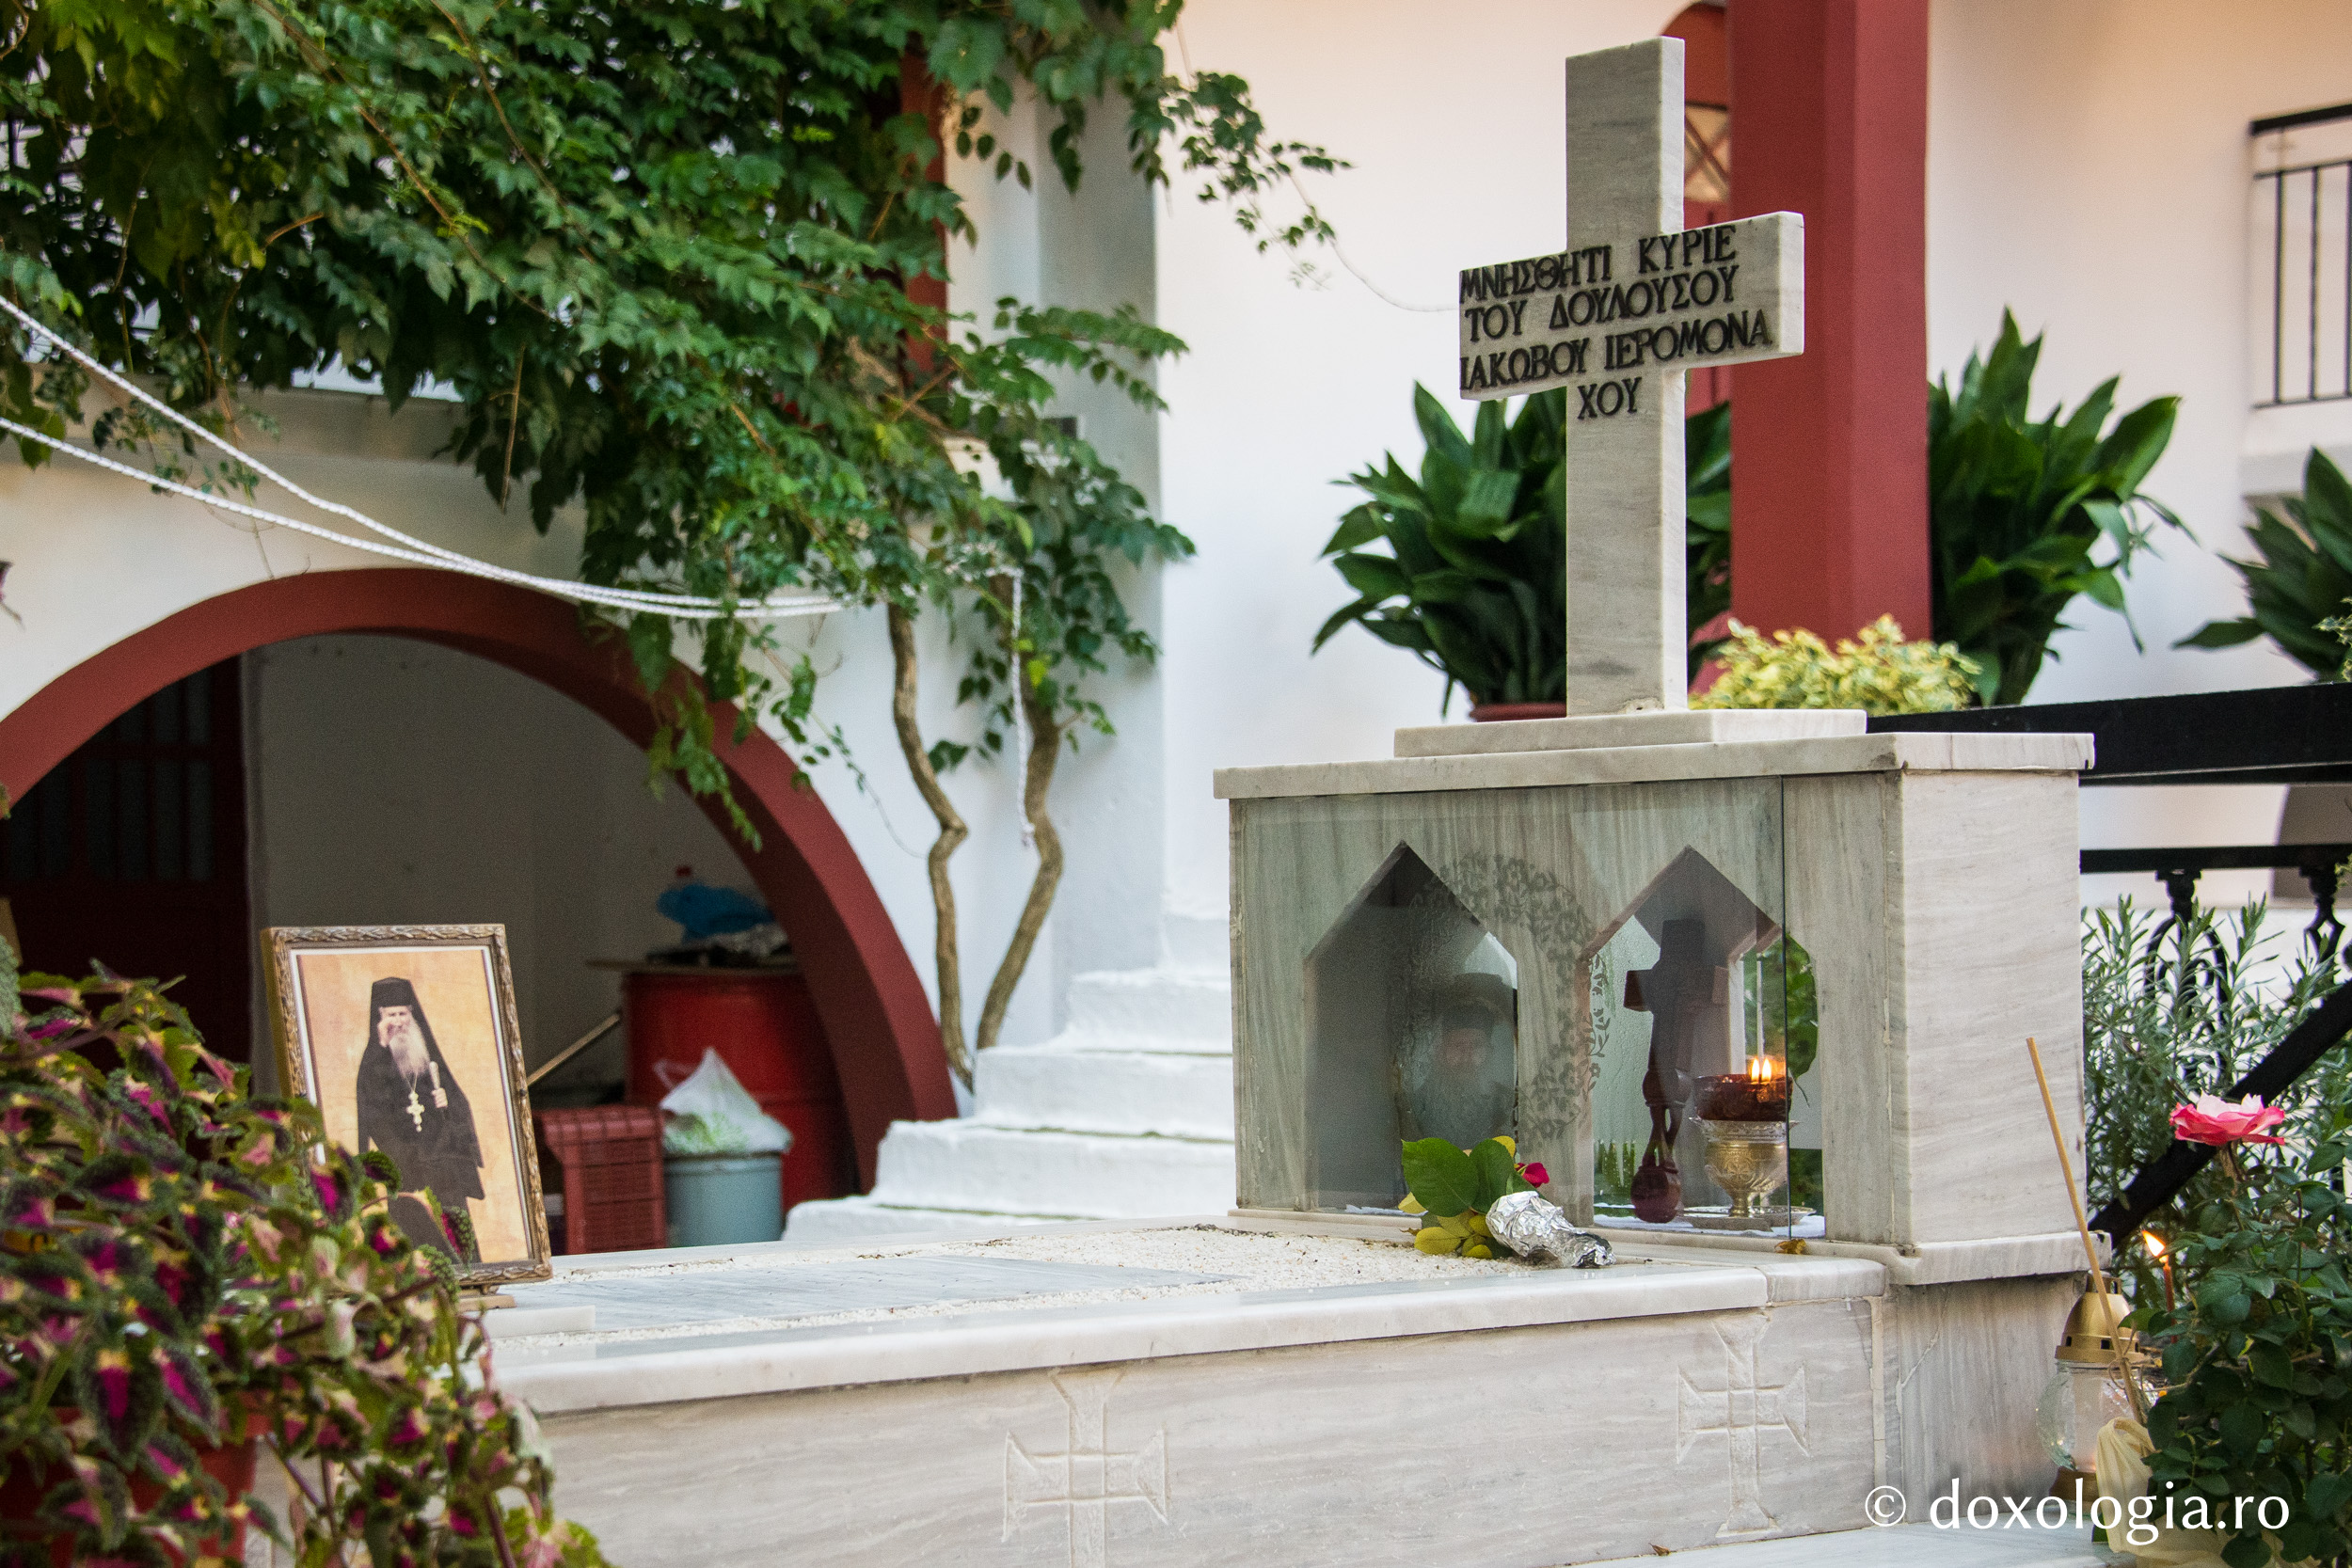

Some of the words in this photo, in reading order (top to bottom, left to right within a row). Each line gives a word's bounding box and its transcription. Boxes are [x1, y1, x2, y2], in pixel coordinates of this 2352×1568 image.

[1460, 245, 1612, 304] ΜΝΗΣΘΗΤΙ
[1638, 225, 1737, 275] ΚΥΡΙΕ
[1460, 337, 1590, 390] ΙΑΚΩΒΟΥ
[1604, 309, 1772, 371] ΙΕΡΟΜΟΝΑ
[1465, 300, 1528, 342] ΤΟΥ
[1577, 377, 1642, 420] ΧΟΥ
